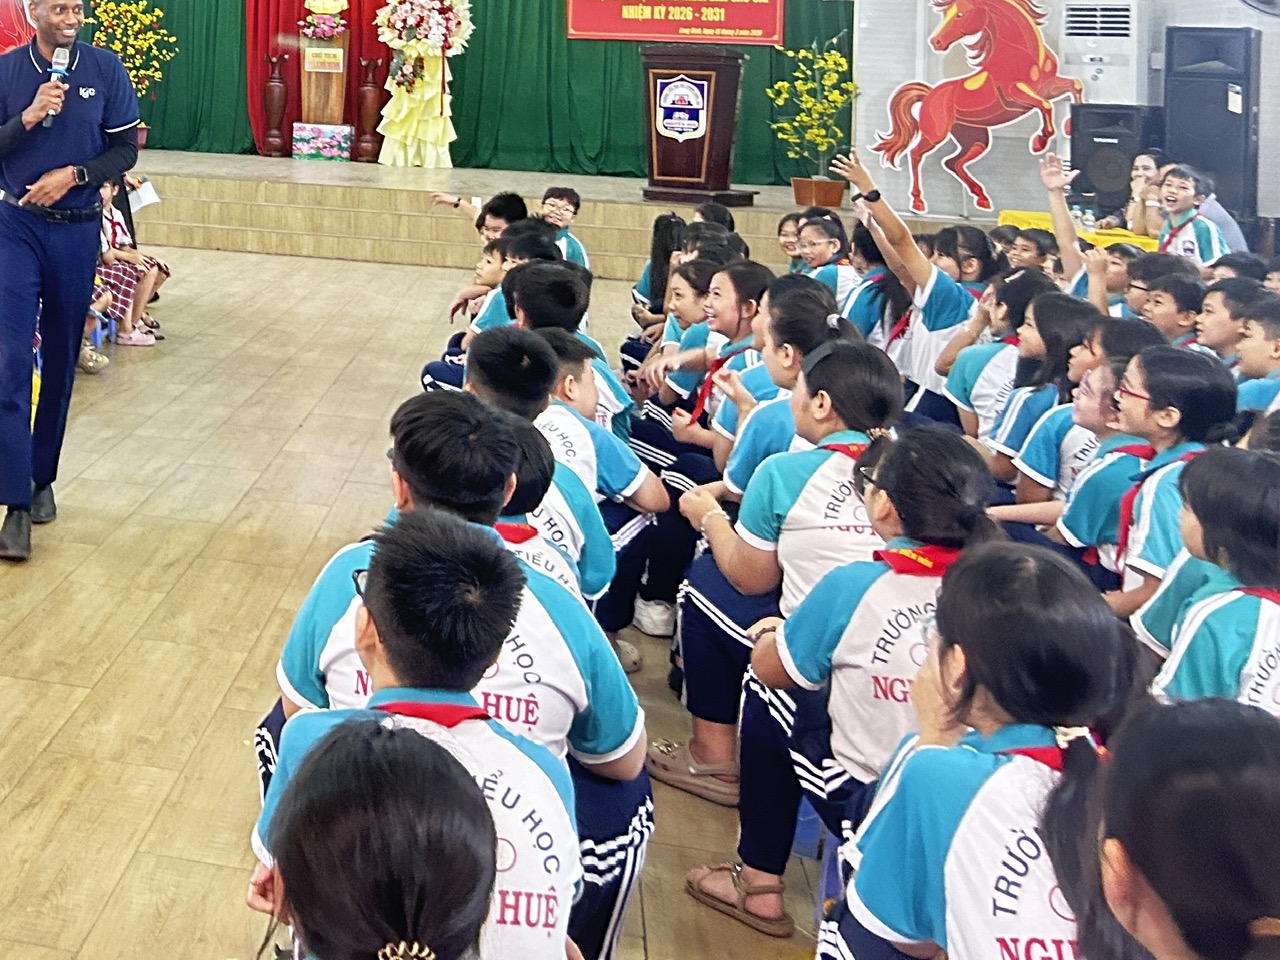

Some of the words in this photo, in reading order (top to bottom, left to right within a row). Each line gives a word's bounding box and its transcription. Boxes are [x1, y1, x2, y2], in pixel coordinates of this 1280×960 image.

[668, 6, 693, 20] 2026
[701, 7, 725, 21] 2031
[823, 480, 854, 520] TRƯỜ
[505, 634, 541, 685] HỌC
[481, 691, 540, 732] HUỆ
[473, 769, 521, 810] ỂU
[521, 808, 561, 875] HỌC
[992, 826, 1042, 917] TRƯỜ
[496, 885, 559, 938] HUỆ
